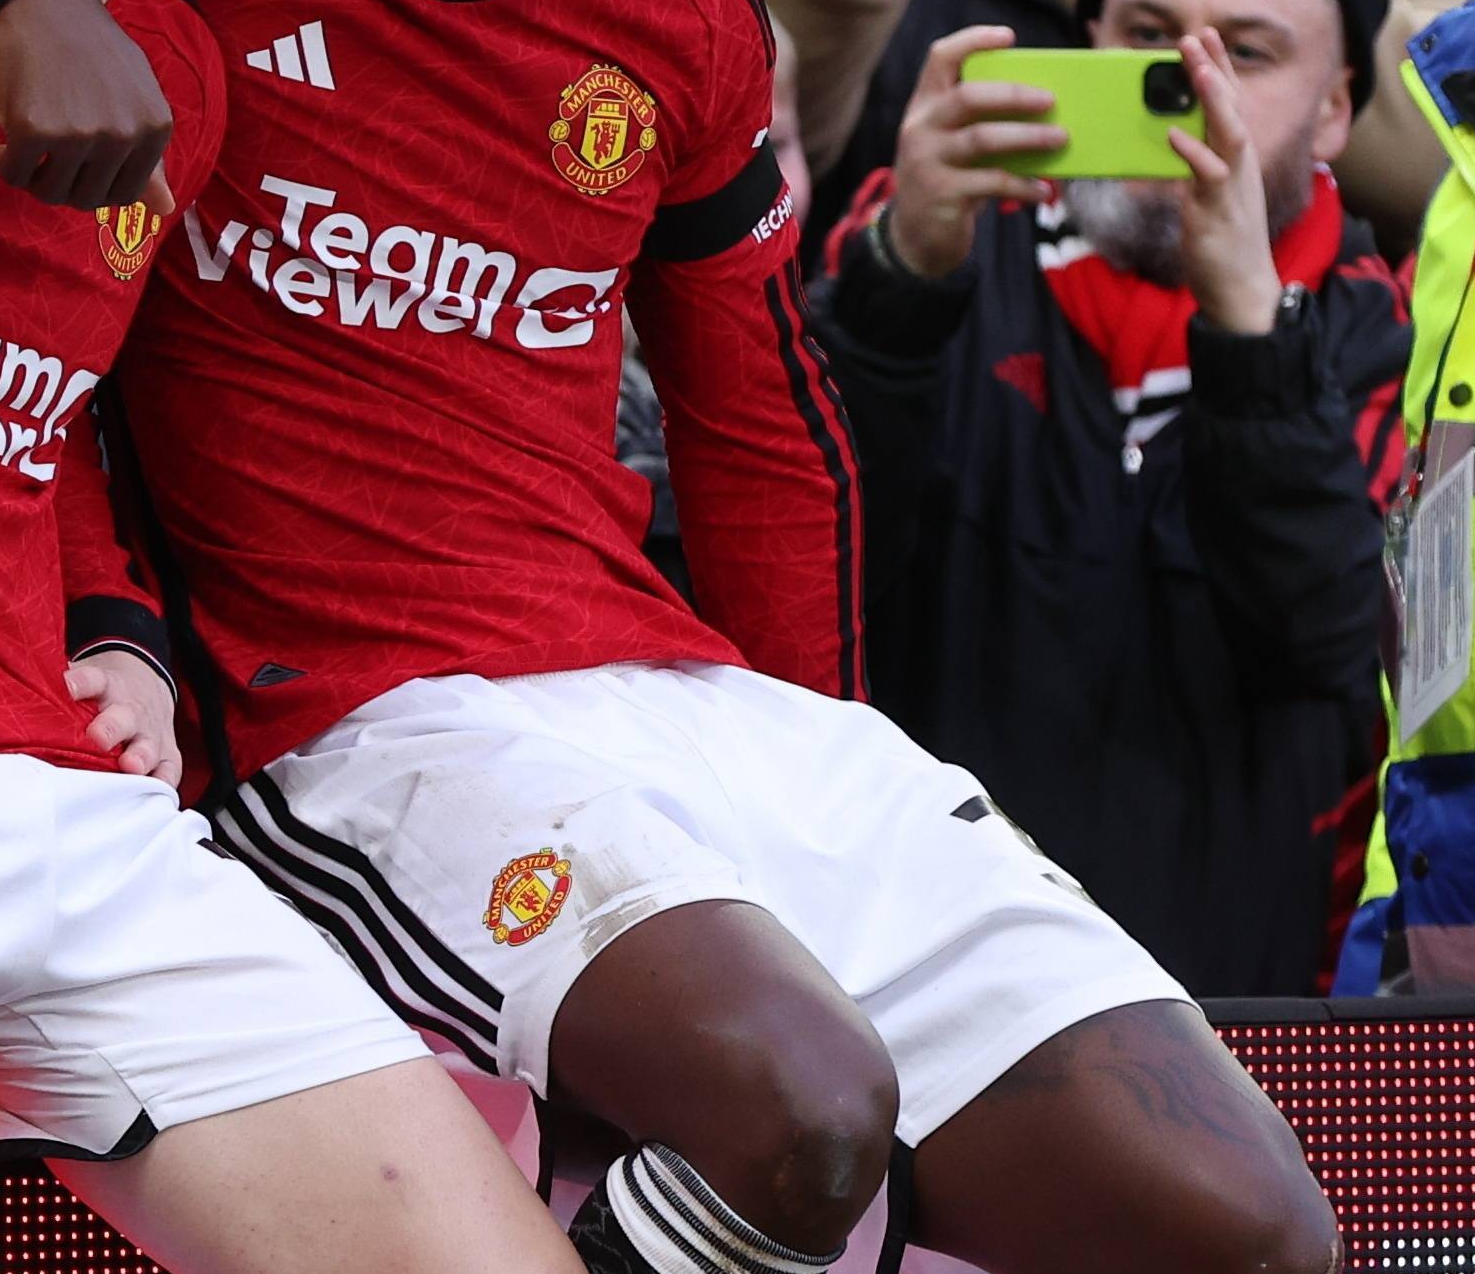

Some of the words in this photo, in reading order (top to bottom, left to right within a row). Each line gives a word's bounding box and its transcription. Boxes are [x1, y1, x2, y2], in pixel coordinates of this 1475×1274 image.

[567, 73, 650, 119] MANCHESTER
[565, 161, 628, 186] UNITED
[107, 245, 143, 271] UNITED
[260, 174, 518, 307] Team
[491, 855, 550, 918] MANCHESTER
[523, 891, 565, 938] UNITED
